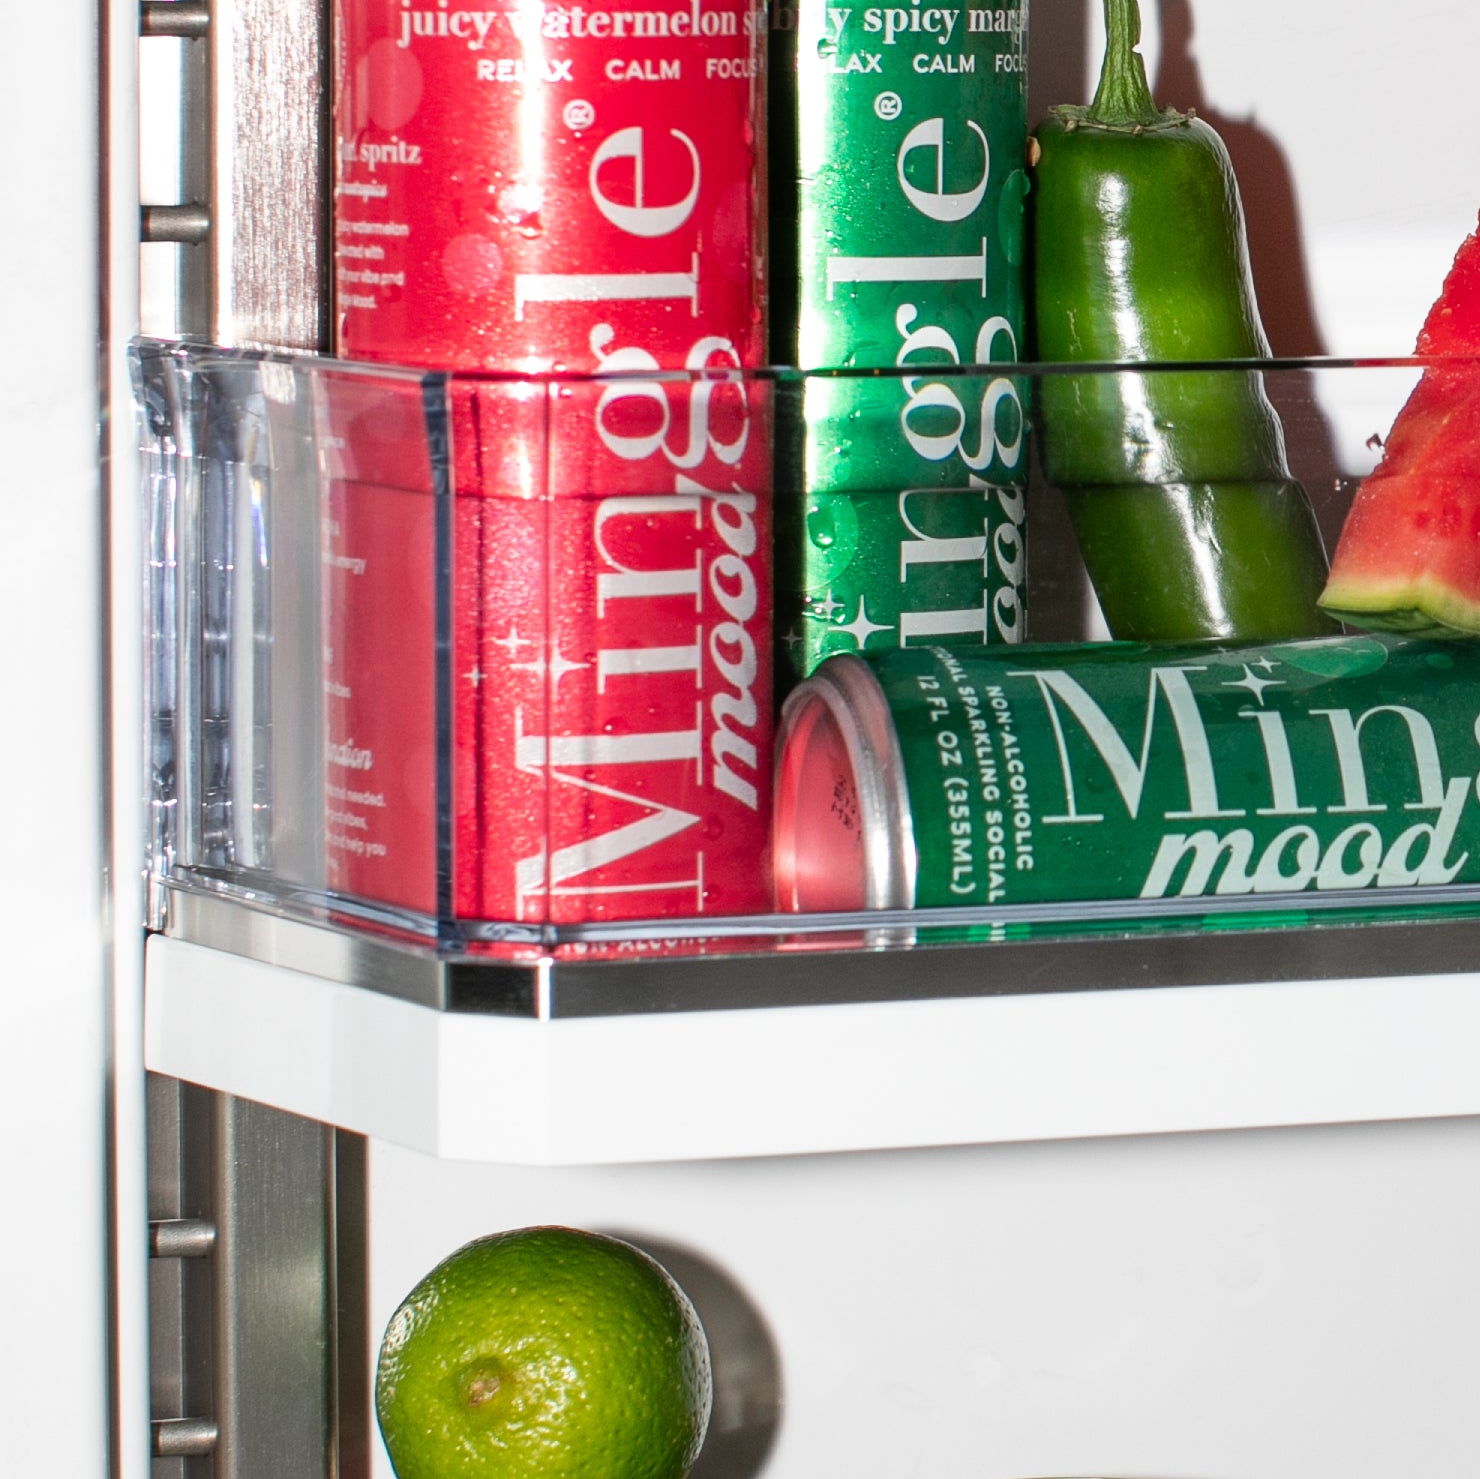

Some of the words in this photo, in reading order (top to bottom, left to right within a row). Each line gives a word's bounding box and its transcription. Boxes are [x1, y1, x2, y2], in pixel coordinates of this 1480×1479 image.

[476, 58, 574, 83] RELAX
[605, 59, 681, 81] CALM
[705, 58, 759, 80] FOCUS
[912, 53, 976, 74] CALM
[360, 135, 423, 172] spritz
[675, 474, 760, 811] mood
[925, 695, 951, 723] FL
[936, 729, 964, 768] OZ
[957, 685, 1002, 803] SPARKLING
[984, 809, 1007, 904] SOCIAL
[985, 684, 1035, 872] NON-ALCOHOLIC
[943, 775, 978, 896] (355ML)
[1138, 775, 1473, 899] mood
